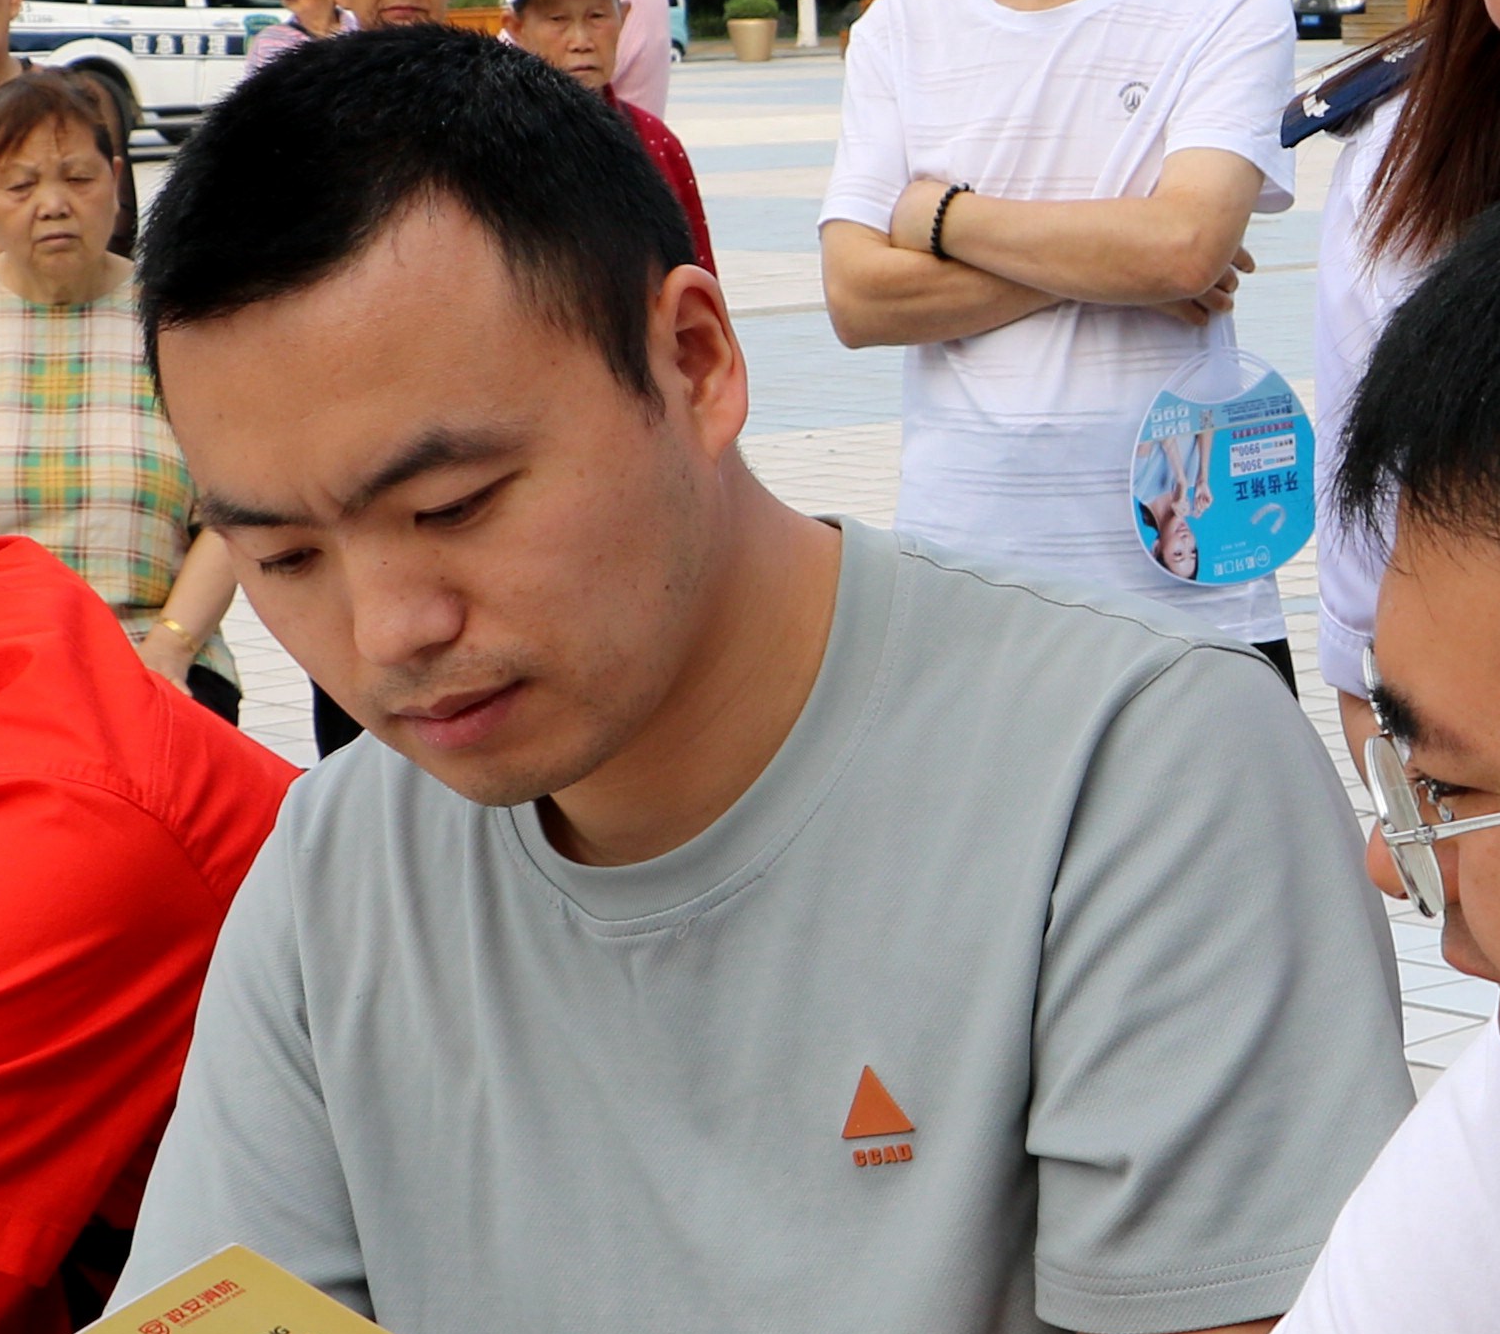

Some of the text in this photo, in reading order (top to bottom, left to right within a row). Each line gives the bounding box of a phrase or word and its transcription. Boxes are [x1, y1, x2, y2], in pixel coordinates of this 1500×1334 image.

[1232, 470, 1299, 502] 牙齿矫正
[163, 1275, 240, 1326] 政安消防
